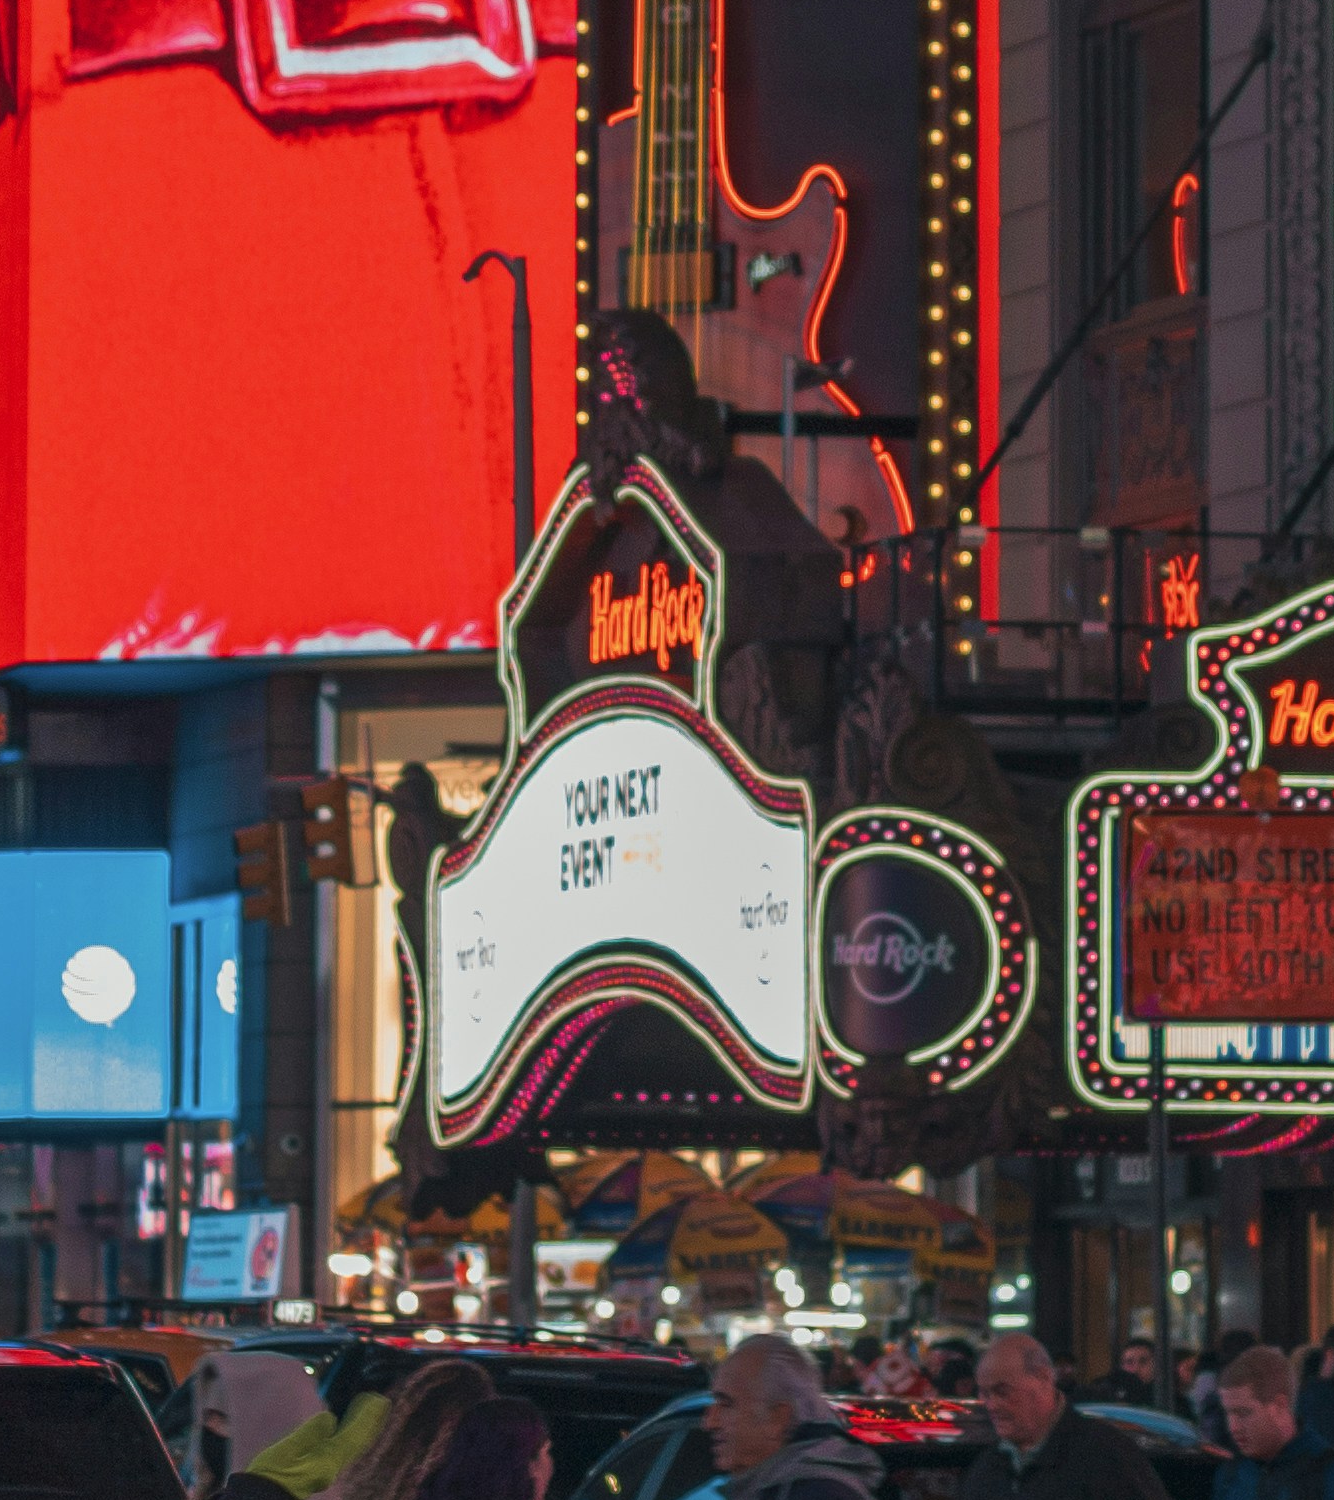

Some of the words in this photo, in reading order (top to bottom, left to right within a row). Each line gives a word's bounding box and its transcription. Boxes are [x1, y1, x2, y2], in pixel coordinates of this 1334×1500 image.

[589, 562, 650, 664] Hard
[649, 560, 704, 673] Rock
[563, 775, 610, 829] YOUR
[614, 763, 662, 818] NEXT
[560, 836, 615, 891] EVENT
[1148, 847, 1238, 883] 42ND
[1142, 898, 1186, 934] NO
[1203, 898, 1282, 935] LEFT
[834, 934, 883, 966] Hard
[883, 934, 955, 973] Rock
[1151, 948, 1217, 986] USE
[1237, 948, 1325, 987] 40TH
